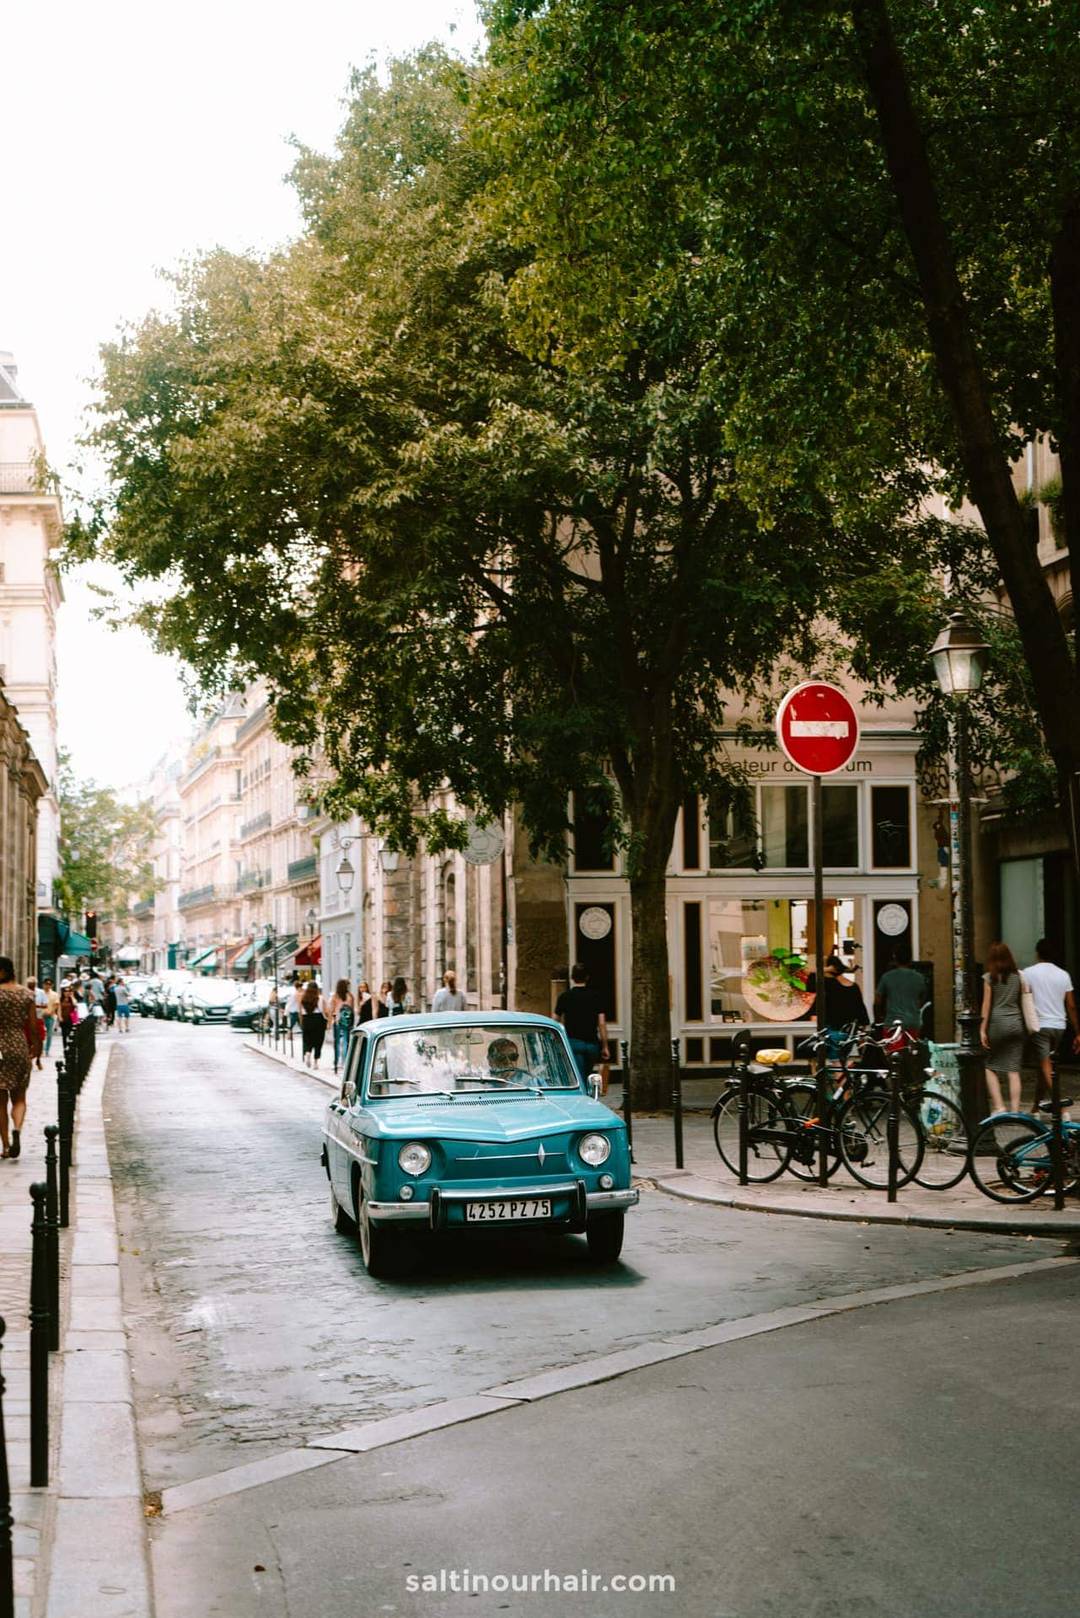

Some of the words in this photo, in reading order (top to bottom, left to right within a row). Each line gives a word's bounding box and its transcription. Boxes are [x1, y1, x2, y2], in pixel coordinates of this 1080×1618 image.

[469, 1203, 506, 1219] 4252
[510, 1202, 528, 1217] PZ
[532, 1201, 549, 1216] 75
